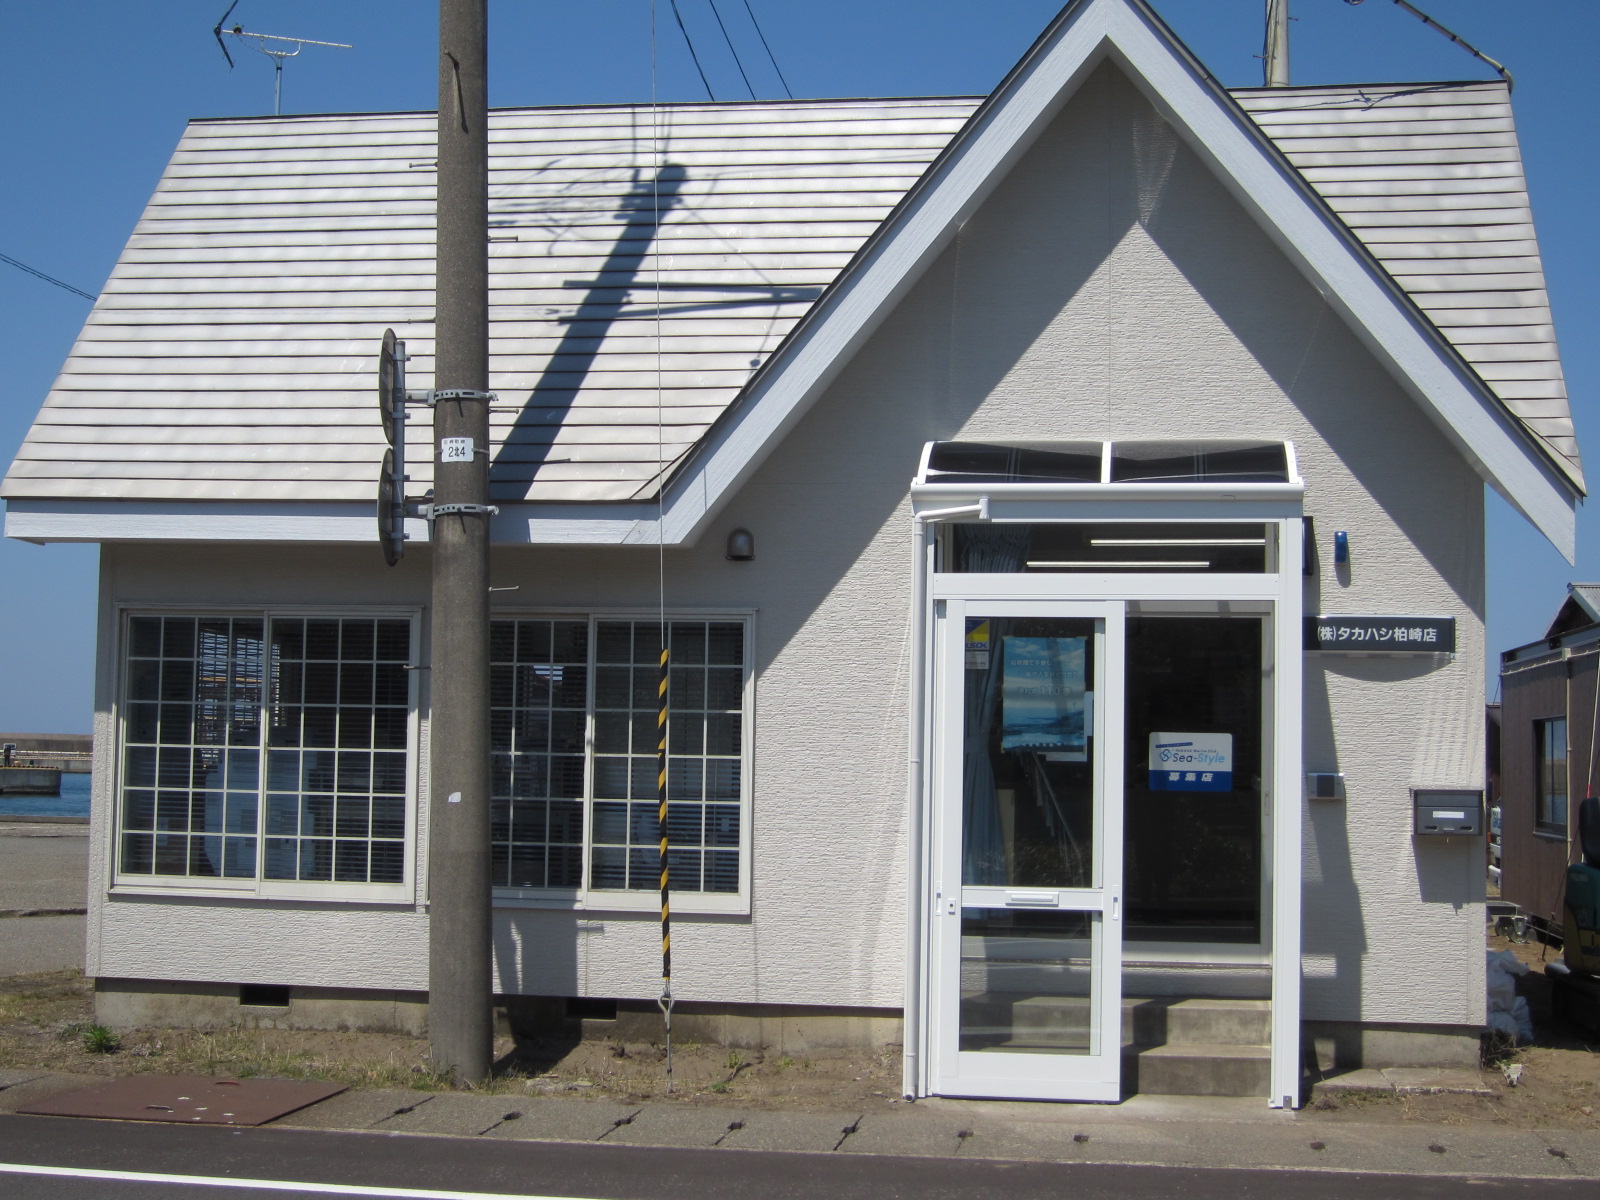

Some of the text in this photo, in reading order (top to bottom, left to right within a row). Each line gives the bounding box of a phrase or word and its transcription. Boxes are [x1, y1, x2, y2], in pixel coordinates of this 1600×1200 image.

[1316, 625, 1437, 643] (株)タカハシ柏崎店
[1173, 752, 1225, 765] Sea-Style
